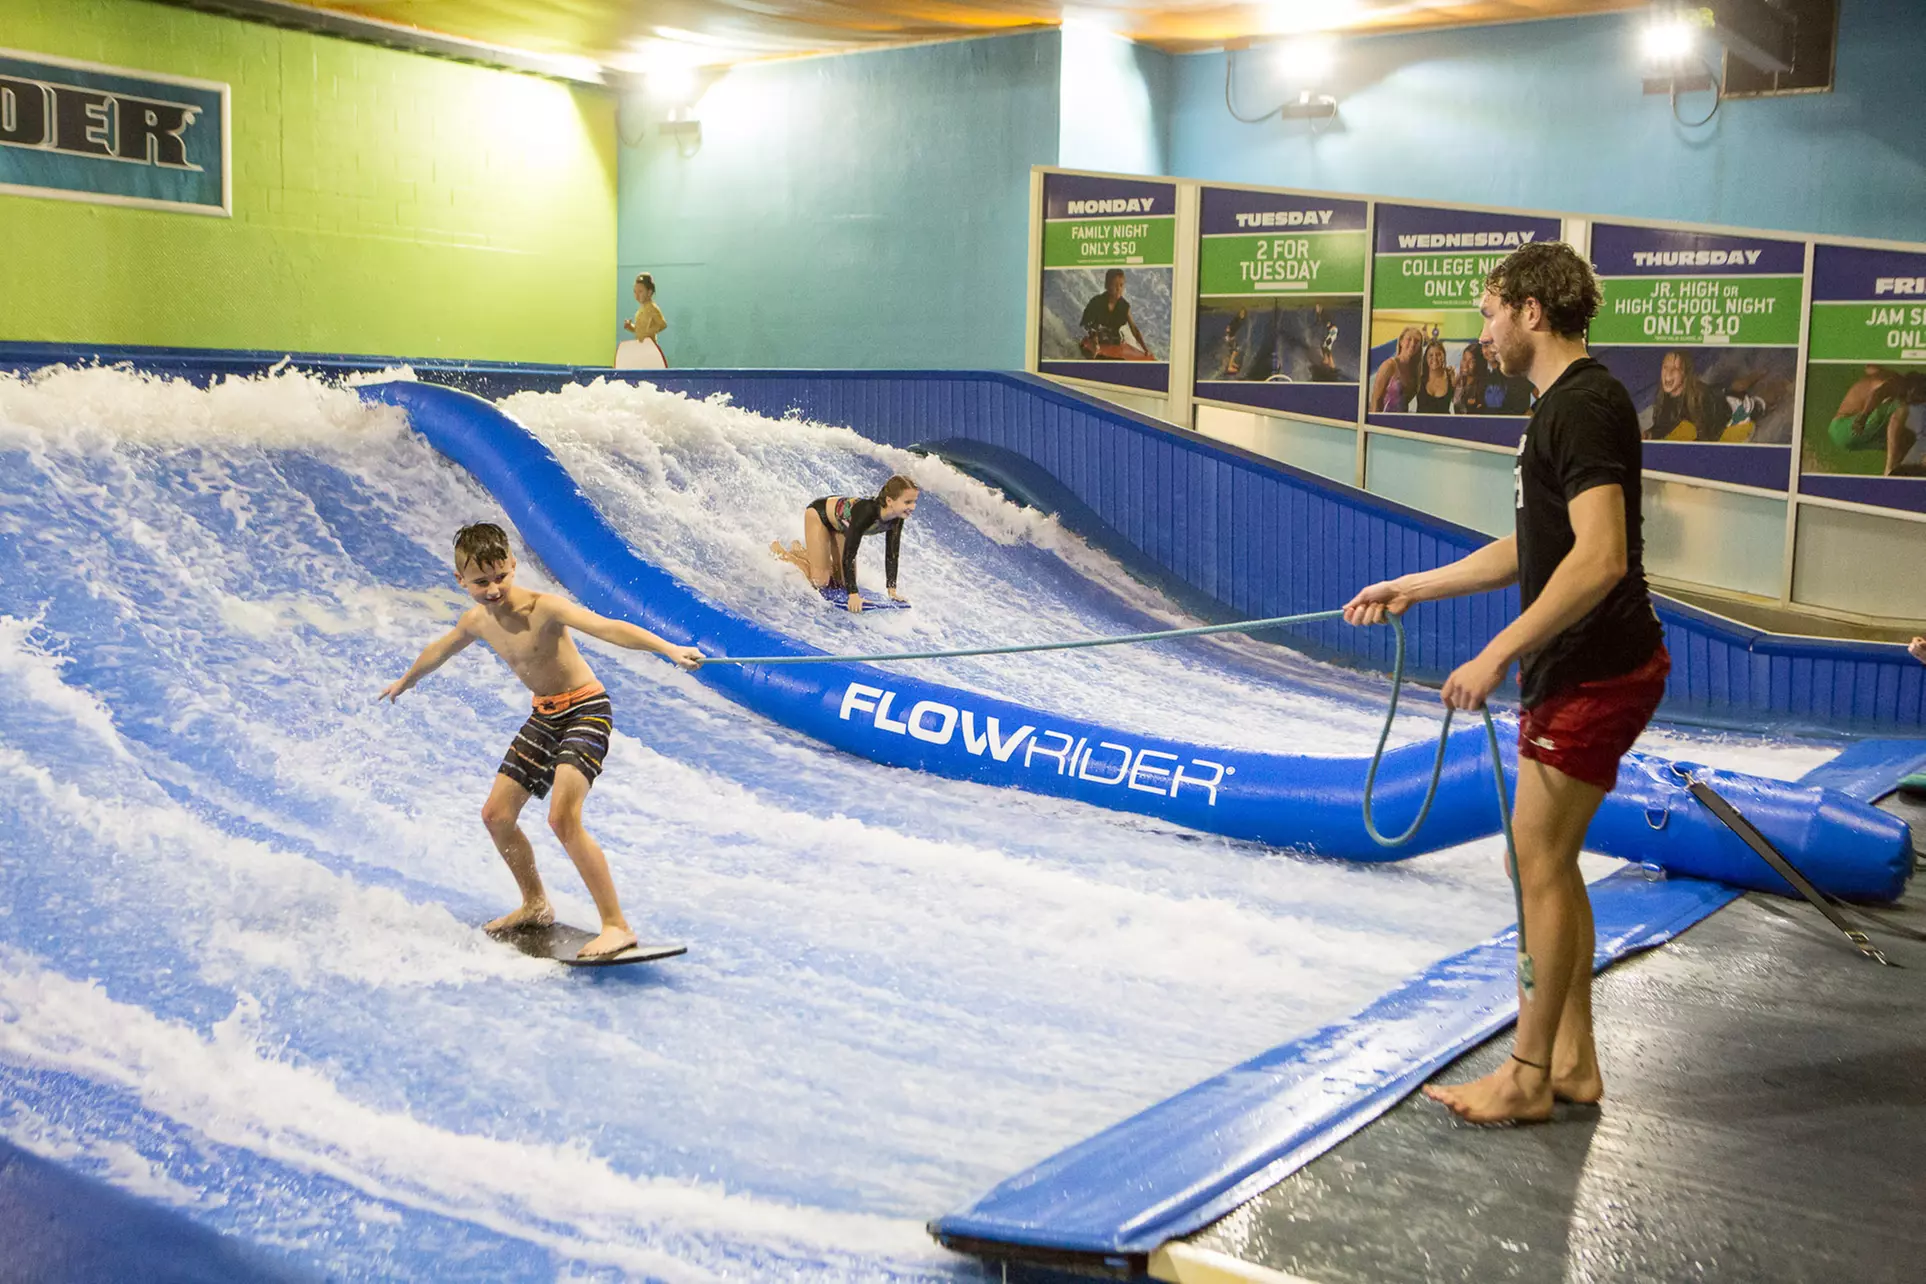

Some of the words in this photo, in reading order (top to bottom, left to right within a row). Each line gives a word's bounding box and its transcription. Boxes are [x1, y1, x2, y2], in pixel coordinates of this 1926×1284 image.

[1067, 198, 1155, 215] MONDAY
[1235, 210, 1334, 227] TUESDAY
[1071, 225, 1111, 240] FAMILY
[1113, 224, 1149, 238] NIGHT
[1398, 231, 1535, 248] WEDNESDAY
[1081, 242, 1111, 256] ONLY
[1112, 240, 1136, 256] $50
[1256, 240, 1268, 260] 2
[1273, 239, 1309, 259] FOR
[1402, 257, 1474, 276] COLLEGE
[1632, 250, 1762, 267] THURSDAY
[1240, 260, 1321, 281] TUESDAY
[1424, 279, 1466, 297] ONLY
[1679, 281, 1719, 297] HIGH
[1723, 285, 1739, 297] OR
[1615, 298, 1653, 315] HIGH
[1657, 298, 1721, 315] SCHOOL
[1725, 298, 1777, 314] NIGHT
[1643, 315, 1696, 336] ONLY
[1700, 314, 1740, 336] $10
[1865, 307, 1905, 327] JAM
